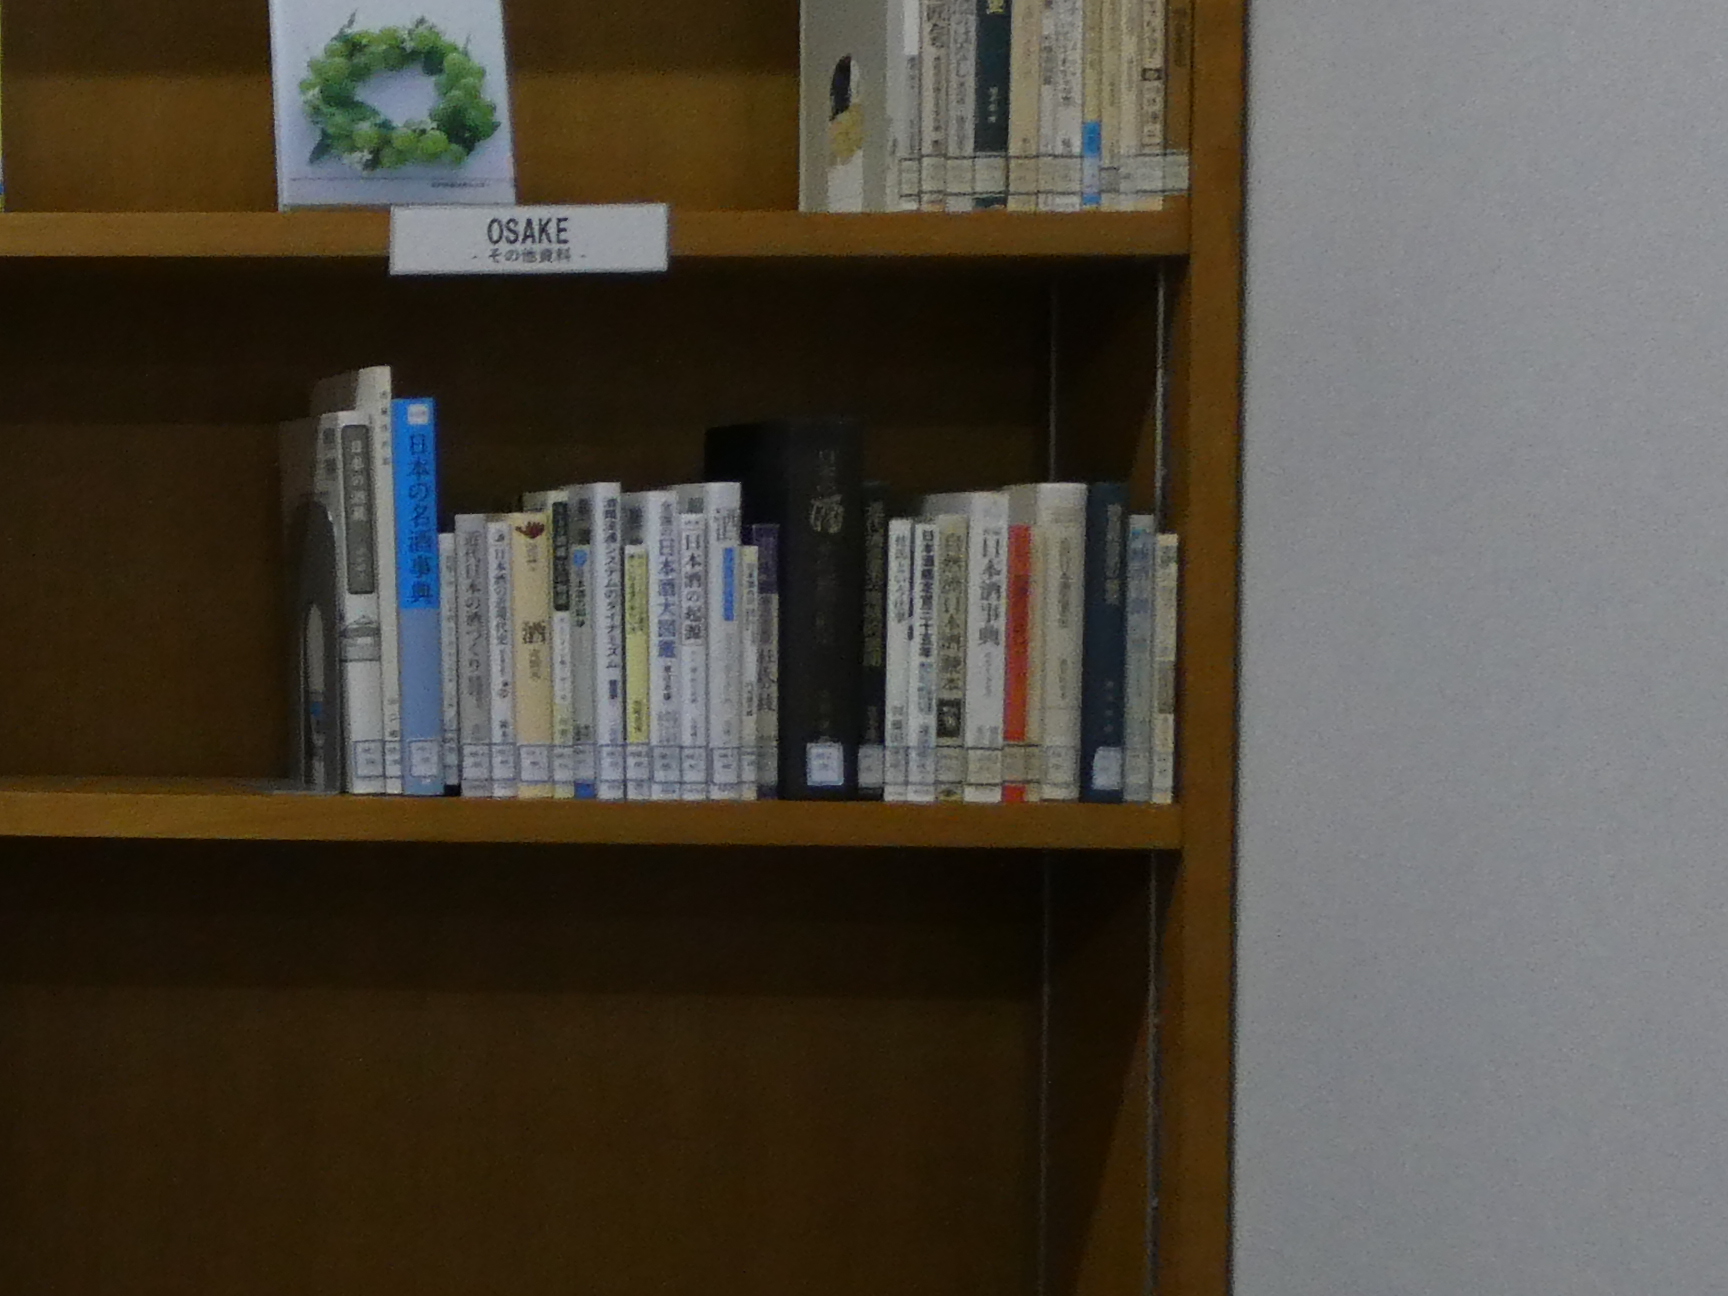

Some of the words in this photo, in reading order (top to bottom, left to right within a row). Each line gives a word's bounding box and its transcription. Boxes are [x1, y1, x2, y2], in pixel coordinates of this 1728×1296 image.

[486, 217, 570, 246] OSAKE
[487, 247, 572, 265] その他資料
[408, 434, 432, 604] 日本の名酒事典
